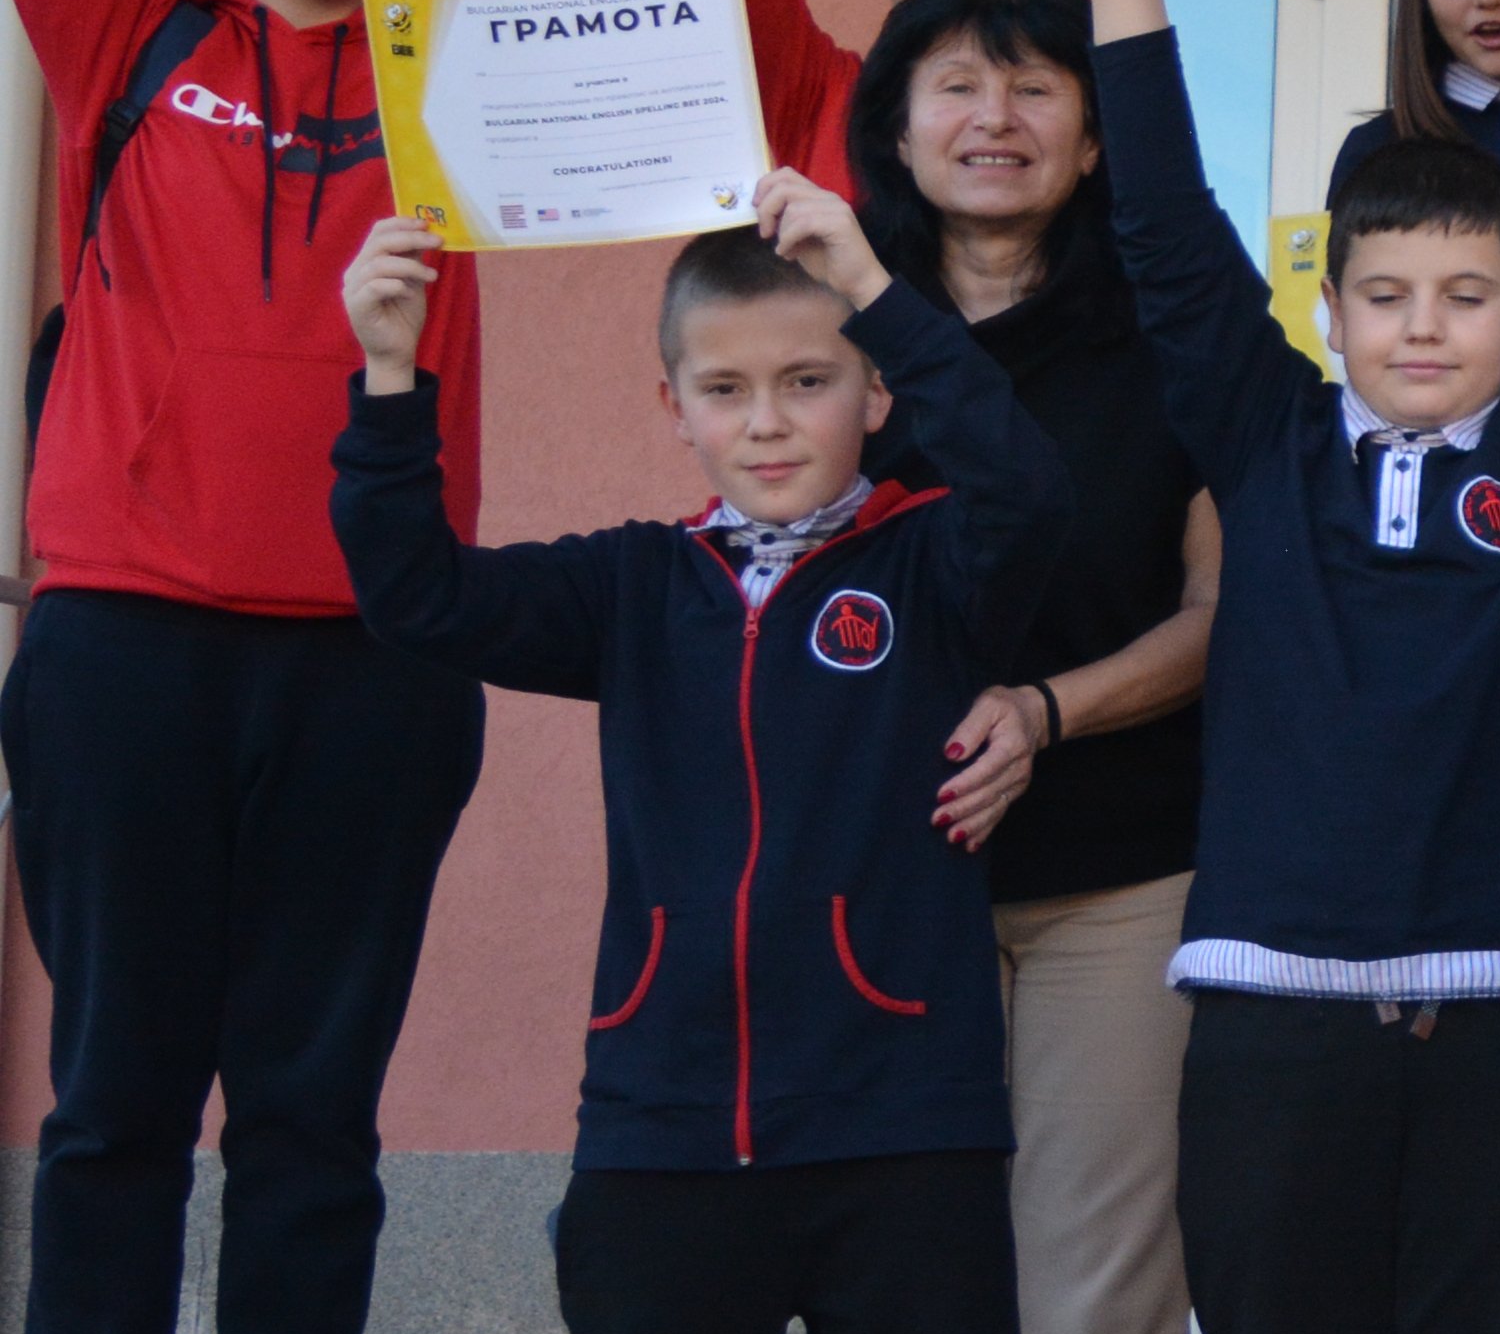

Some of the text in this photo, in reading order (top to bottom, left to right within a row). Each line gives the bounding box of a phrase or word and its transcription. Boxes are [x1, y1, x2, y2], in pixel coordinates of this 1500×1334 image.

[489, 1, 699, 43] ГРАМОТА
[391, 43, 415, 57] BEE
[553, 155, 673, 176] CONGRATULATIONS!
